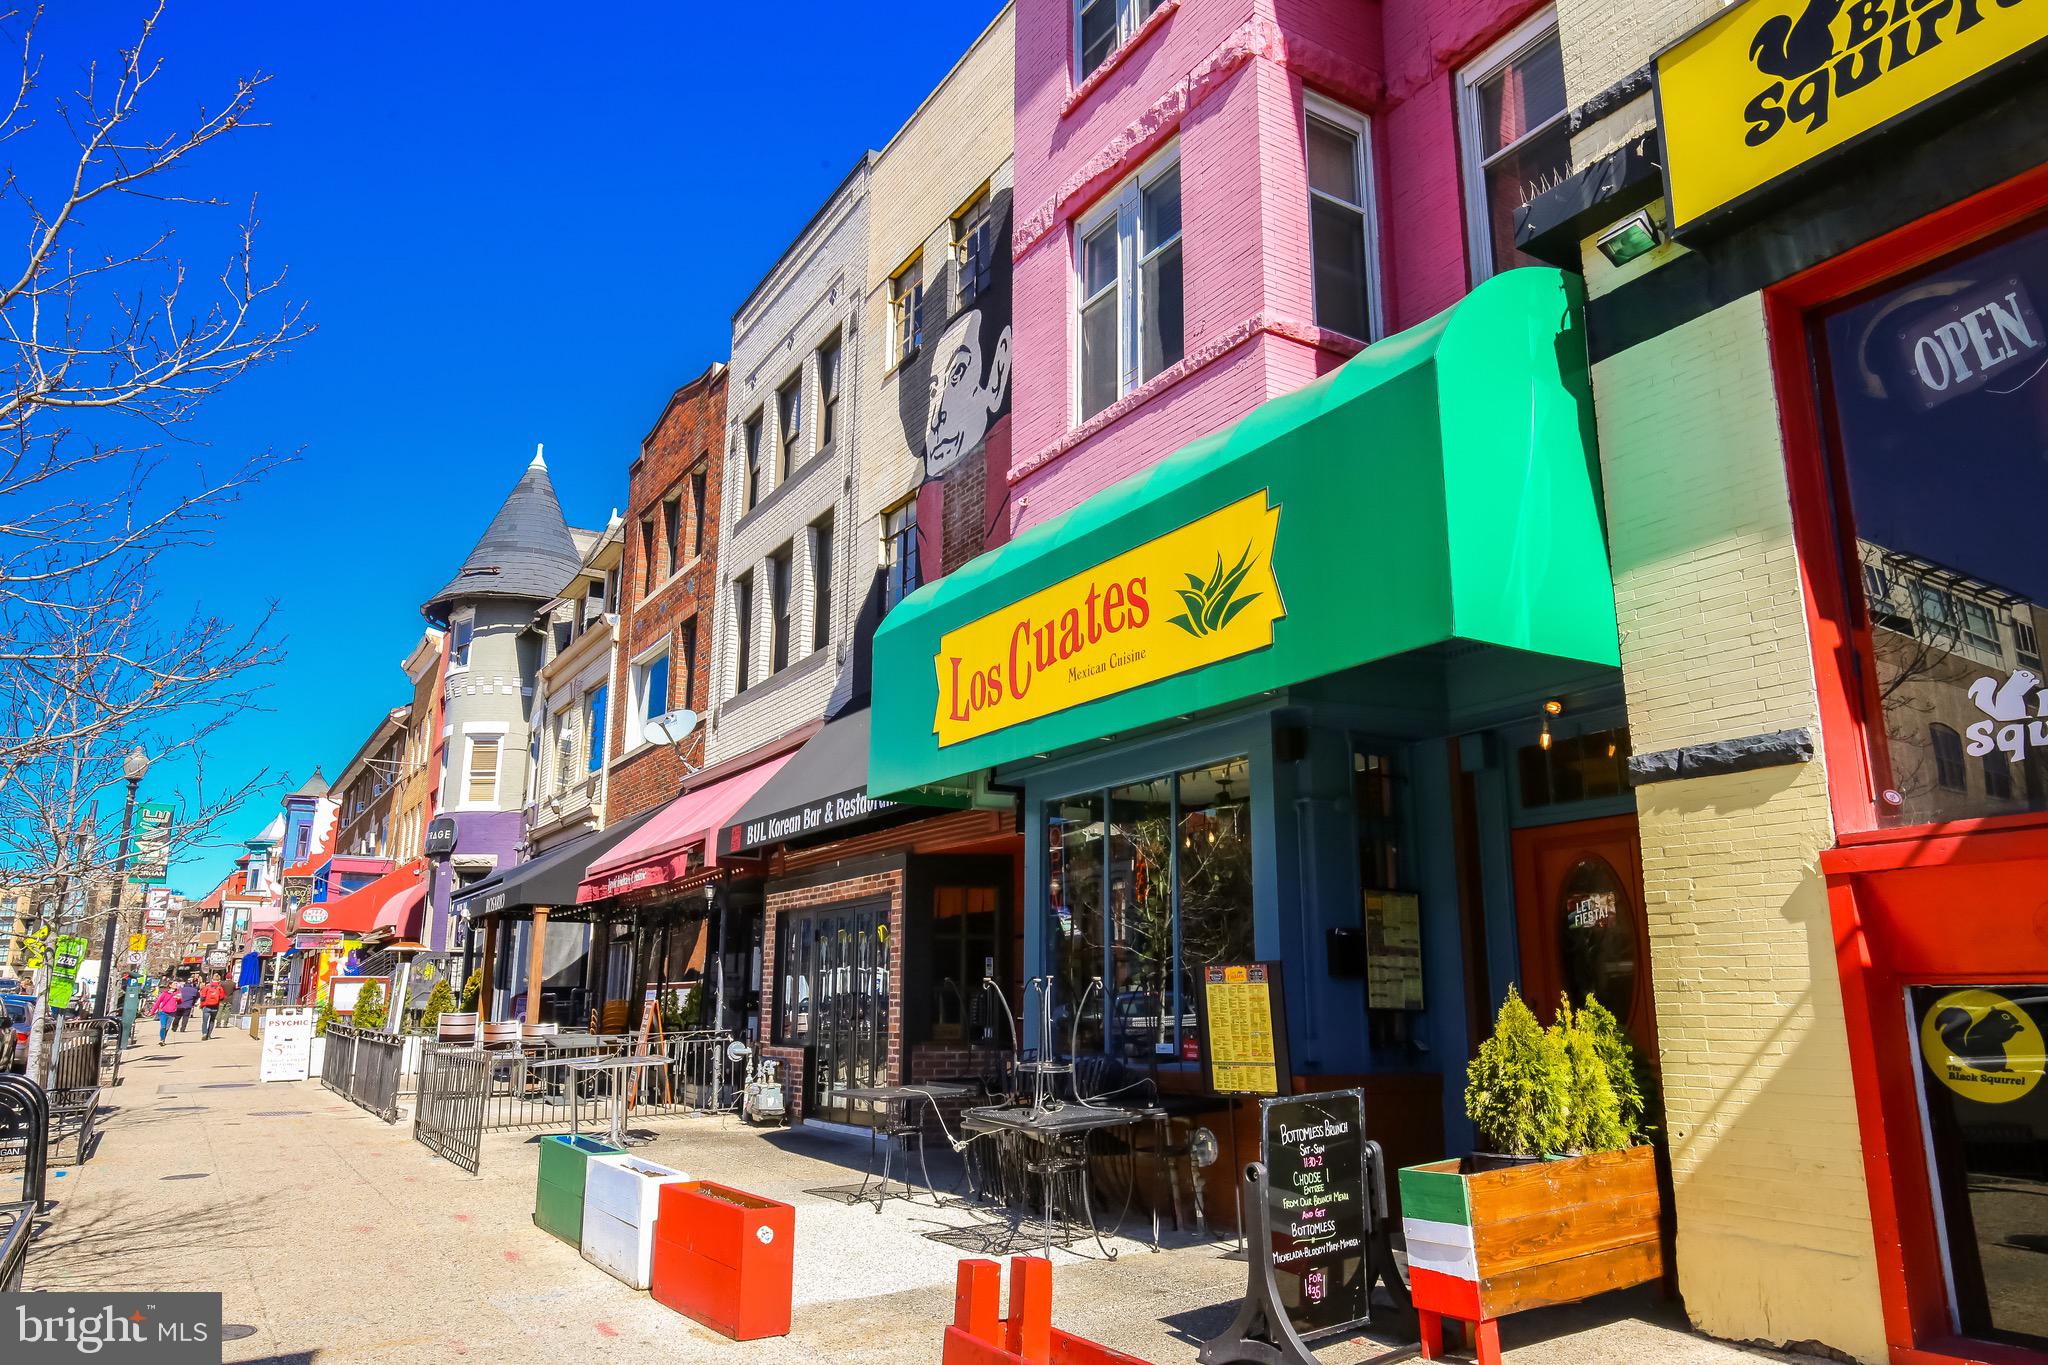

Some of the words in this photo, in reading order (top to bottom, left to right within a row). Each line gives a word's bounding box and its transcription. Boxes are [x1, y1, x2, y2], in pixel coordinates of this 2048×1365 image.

[1744, 0, 2023, 147] Squirr
[1914, 292, 2038, 391] OPEN
[949, 657, 1003, 721] Los
[1009, 576, 1150, 700] Cuates
[1068, 660, 1107, 683] Mexican
[1109, 648, 1147, 669] Cuisine
[746, 824, 767, 845] BUL
[768, 814, 801, 839] Korean
[803, 807, 822, 829] Bar
[824, 801, 833, 823] &
[836, 792, 898, 820] Restaura
[1576, 895, 1601, 913] LET'S
[1574, 905, 1609, 927] FIESTA!
[268, 1019, 309, 1027] PSYCHIC
[1946, 1064, 1962, 1072] The
[1948, 1071, 1978, 1082] Black
[1980, 1074, 2026, 1086] Squirrel
[1280, 1124, 1324, 1146] BOTTOMLESS
[1324, 1119, 1349, 1137] BRUNCH
[1293, 1171, 1321, 1186] CHOOSE
[1303, 1183, 1325, 1195] ENTREE
[1282, 1197, 1299, 1209] FROM
[1299, 1197, 1313, 1207] OUR
[1313, 1194, 1332, 1207] BRUNCH
[1333, 1191, 1349, 1202] MENU
[1301, 1210, 1314, 1220] AND
[1314, 1207, 1326, 1217] GET
[1291, 1219, 1336, 1238] BOTTOMLESS
[1308, 1272, 1323, 1284] FOR
